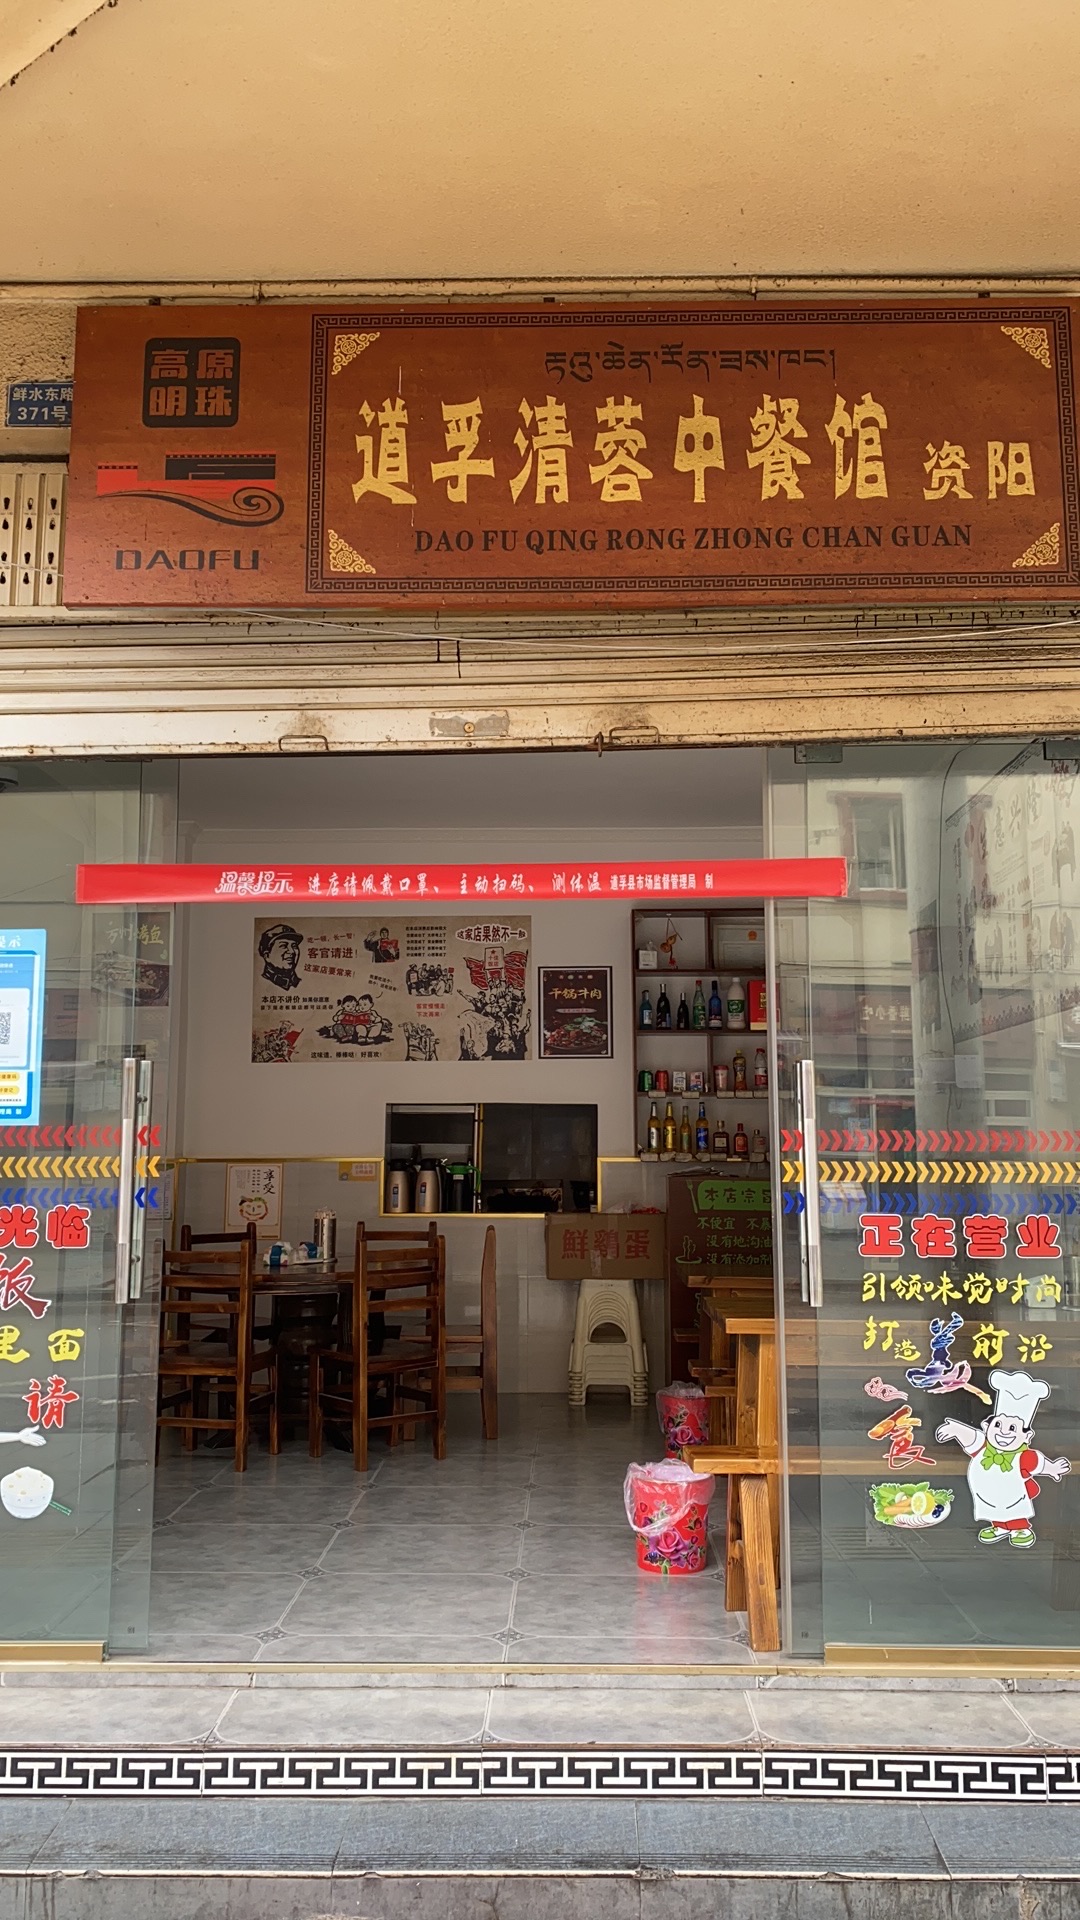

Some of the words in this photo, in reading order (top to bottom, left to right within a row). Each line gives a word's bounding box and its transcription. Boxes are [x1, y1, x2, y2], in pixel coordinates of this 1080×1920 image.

[150, 349, 233, 379] 高原
[12, 387, 73, 401] 鲜水东路
[150, 386, 232, 416] 明珠
[17, 405, 68, 421] 371号
[352, 392, 888, 504] 道孚清蓉中餐馆
[923, 440, 1036, 500] 资阳
[414, 530, 474, 551] DAO
[482, 530, 517, 551] FU
[525, 529, 598, 555] QING
[606, 528, 687, 551] RONG
[694, 527, 794, 549] ZHONG
[802, 526, 883, 548] CHAN
[891, 525, 972, 547] GUAN
[115, 549, 259, 571] DAOFU
[215, 871, 294, 896] 温馨提示
[456, 925, 527, 943] 这家店果然不一般
[261, 996, 301, 1004] 本店不讲价
[548, 987, 602, 1000] 干锅牛肉
[263, 1169, 276, 1195] 享受
[704, 1187, 771, 1204] 本店宗旨
[0, 1204, 90, 1248] 光临
[697, 1217, 735, 1230] 不便宜
[858, 1213, 1062, 1259] 正在营业
[862, 1271, 1061, 1305] 引领味觉时尚
[972, 1323, 1053, 1366] 前沿
[23, 1374, 80, 1430] 请
